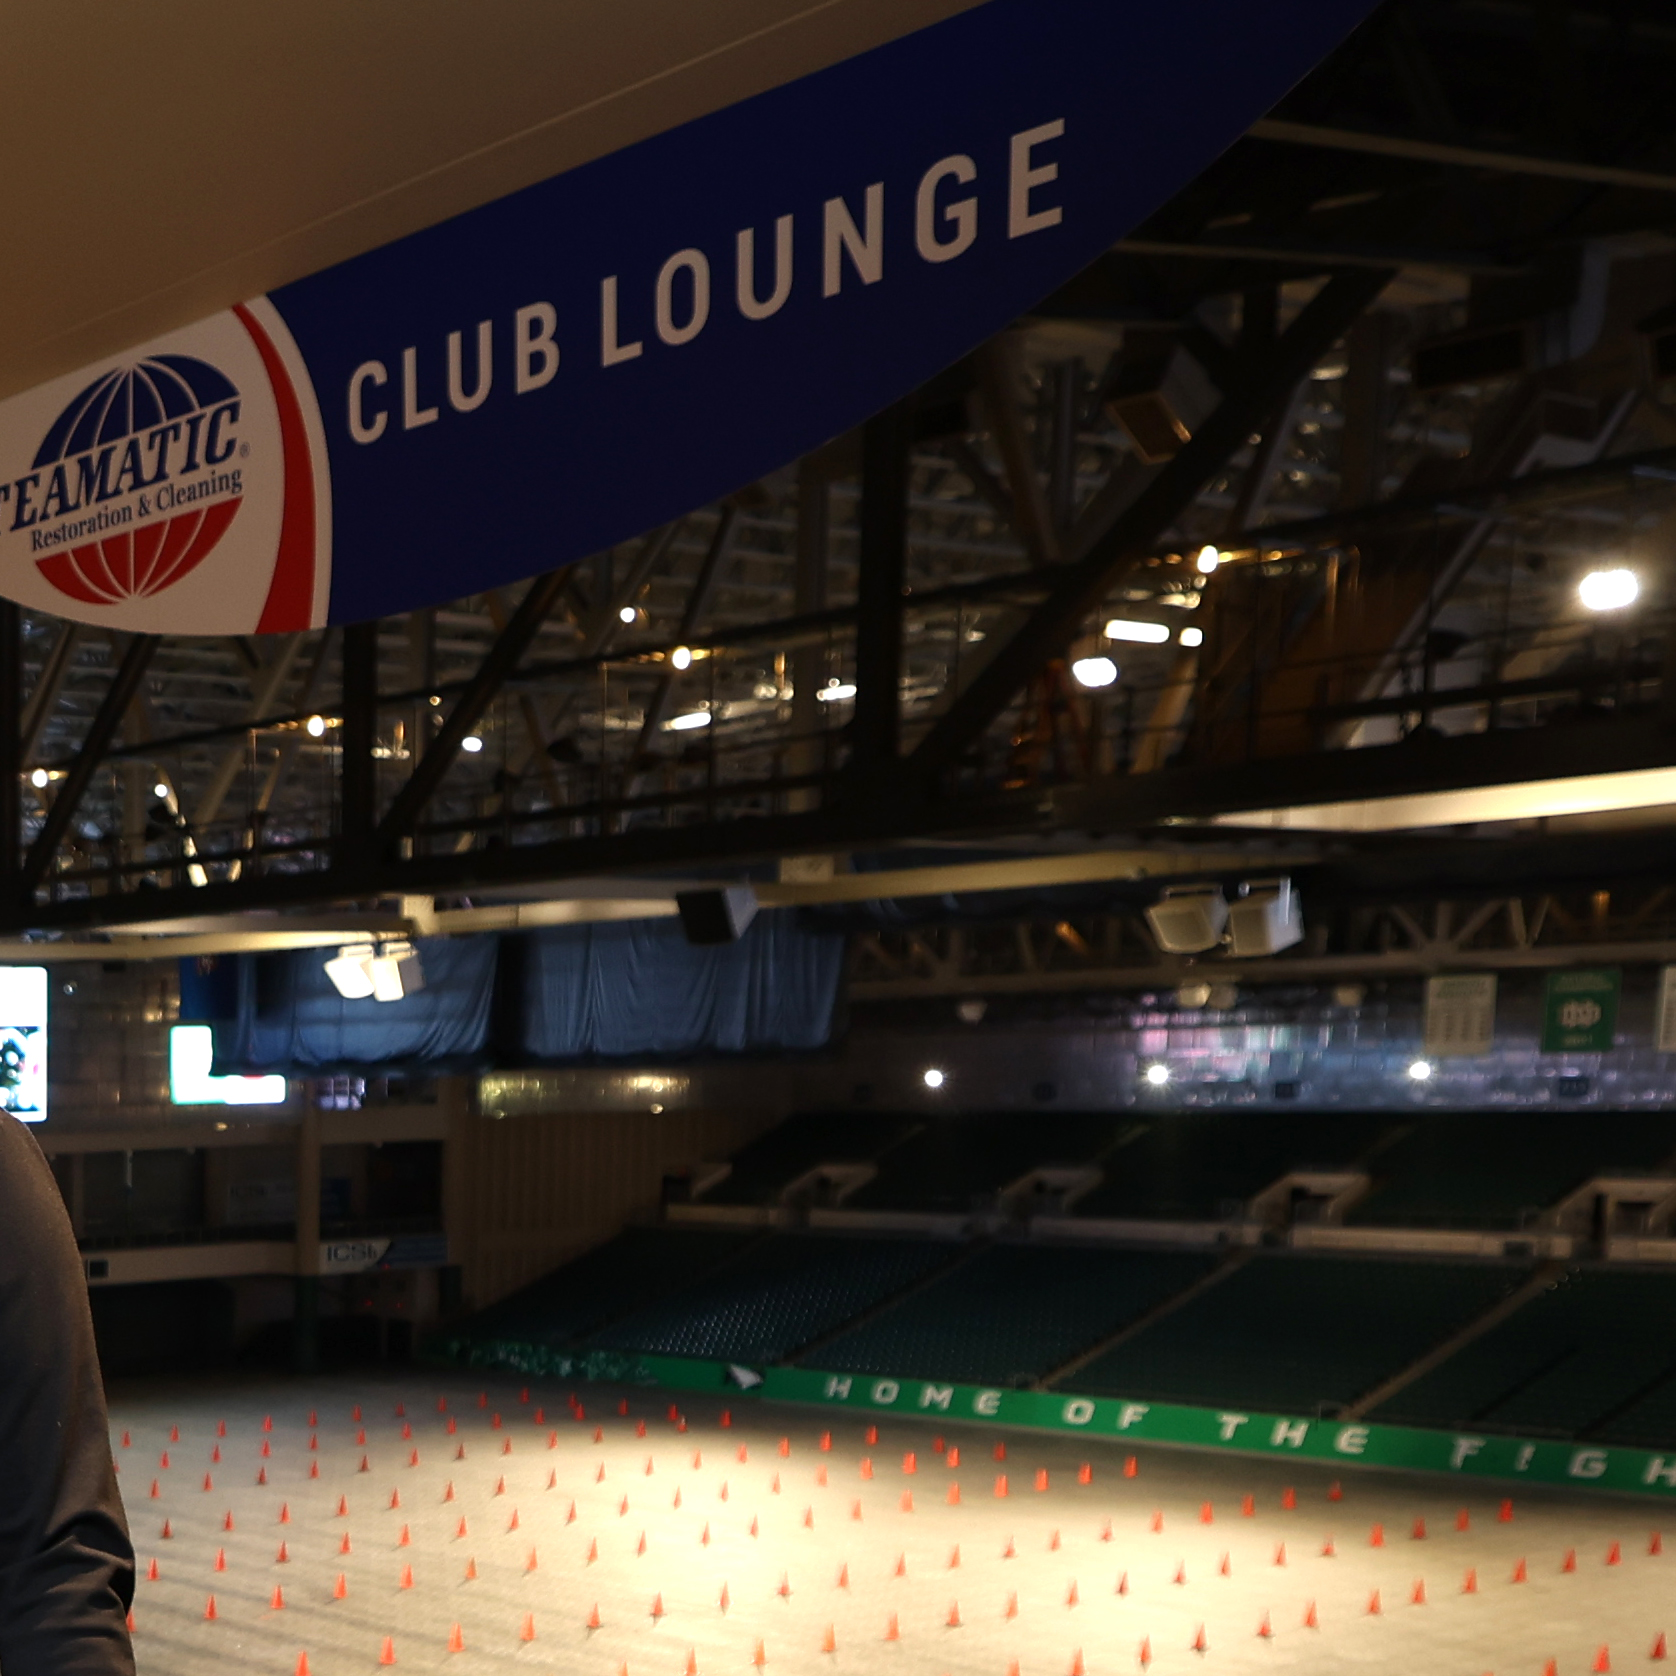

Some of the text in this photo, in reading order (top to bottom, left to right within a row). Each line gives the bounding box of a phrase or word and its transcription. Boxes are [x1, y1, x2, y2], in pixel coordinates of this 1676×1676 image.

[346, 117, 1066, 447] CLUB LOUNGE
[31, 468, 244, 552] Restoration & Cleaning
[824, 1374, 1002, 1416] HOME
[1062, 1398, 1151, 1430] OF
[1216, 1411, 1370, 1456] THE
